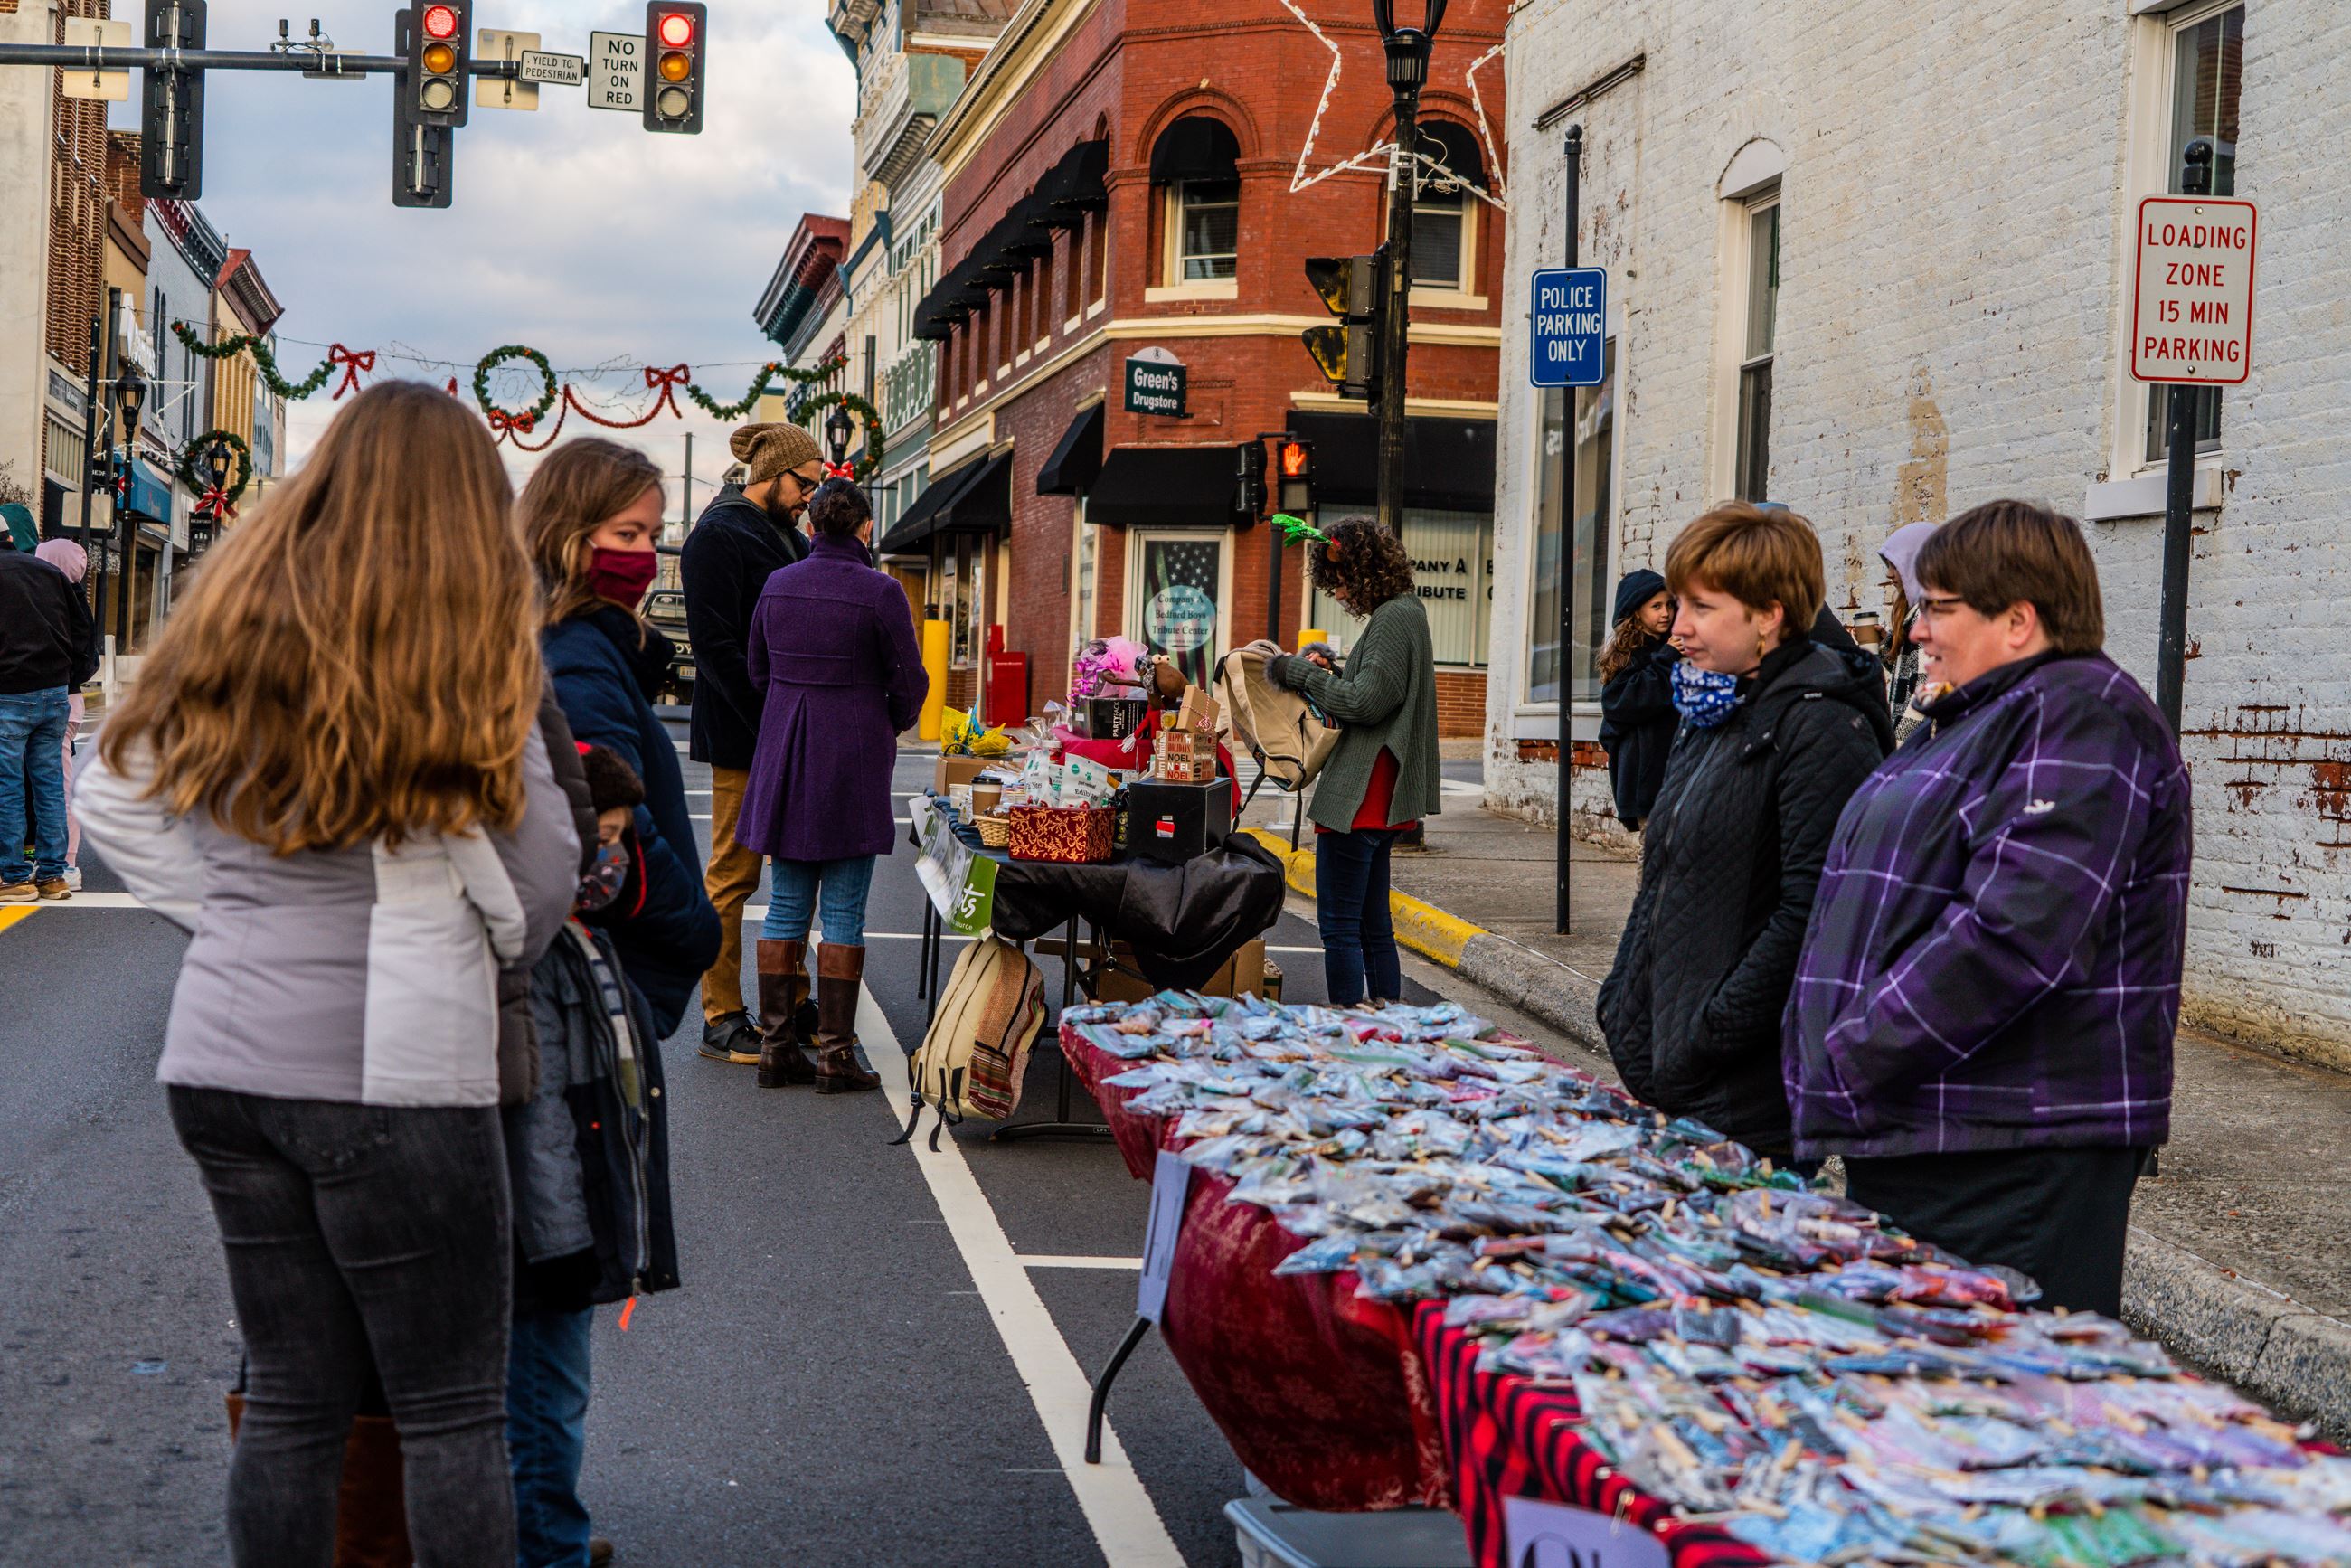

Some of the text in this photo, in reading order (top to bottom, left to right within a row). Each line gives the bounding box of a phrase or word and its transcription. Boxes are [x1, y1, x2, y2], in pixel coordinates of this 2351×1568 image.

[608, 39, 635, 55] NO
[533, 55, 571, 69] YIELD TO
[602, 58, 638, 72] TURN
[525, 68, 578, 81] PEDESTRIAN
[610, 75, 628, 88] ON
[606, 91, 633, 104] RED
[2148, 223, 2247, 250] LOADING
[2166, 262, 2224, 287] ZONE
[1541, 286, 1594, 309] POLICE
[2158, 299, 2229, 325] 15 MIN
[1537, 312, 1601, 336] PARKING
[1548, 338, 1588, 362] ONLY
[2144, 336, 2240, 363] PARKING
[1133, 367, 1178, 391] Green's
[1133, 392, 1178, 410] Drugstore
[1455, 557, 1467, 573] A
[1157, 594, 1194, 606] Company
[1156, 609, 1206, 620] Bedford Boys
[1152, 625, 1208, 635] Tribute Center
[1167, 753, 1191, 763] NOEL
[1167, 770, 1191, 780] NOEL
